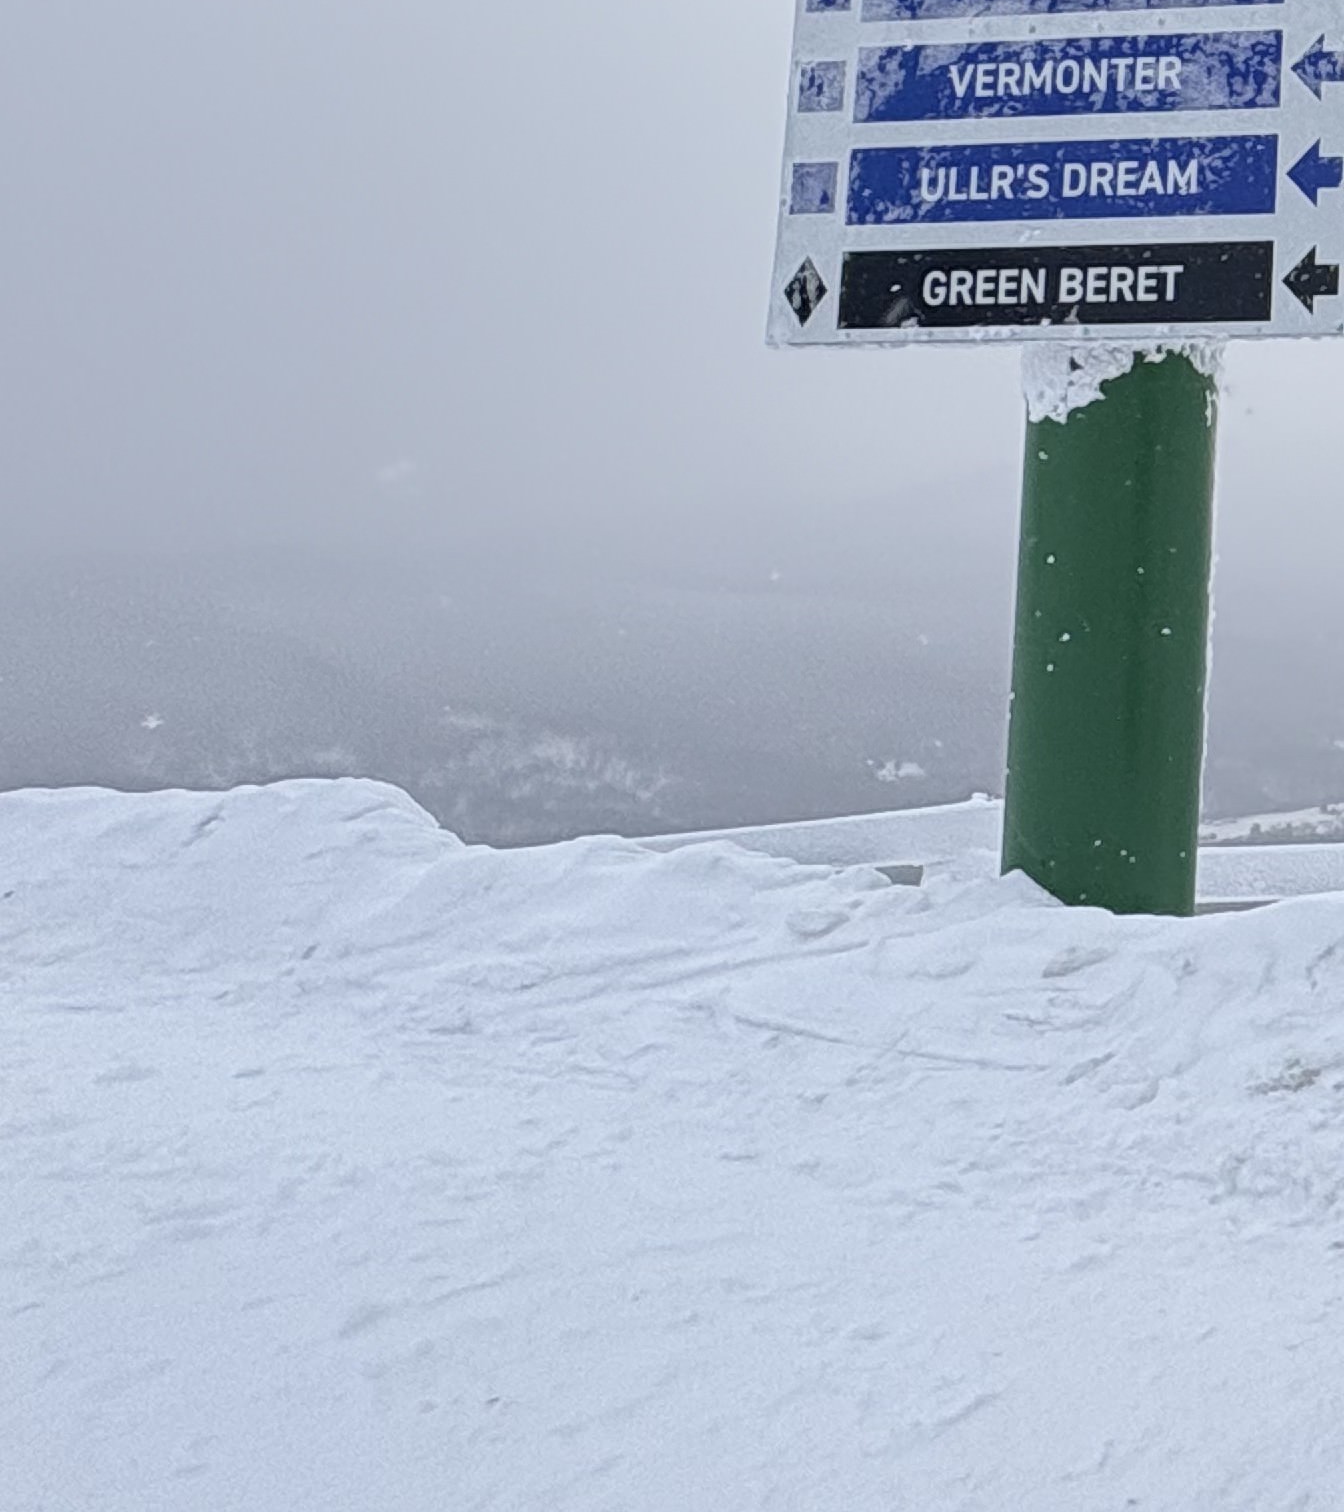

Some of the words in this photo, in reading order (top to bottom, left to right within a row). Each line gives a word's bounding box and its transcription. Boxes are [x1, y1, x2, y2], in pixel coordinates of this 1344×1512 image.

[949, 56, 1182, 99] VERMONTER
[919, 161, 1050, 202] ULLR'S
[1062, 159, 1198, 197] DREAM
[922, 268, 1045, 307] GREEN
[1059, 265, 1184, 303] BERET
